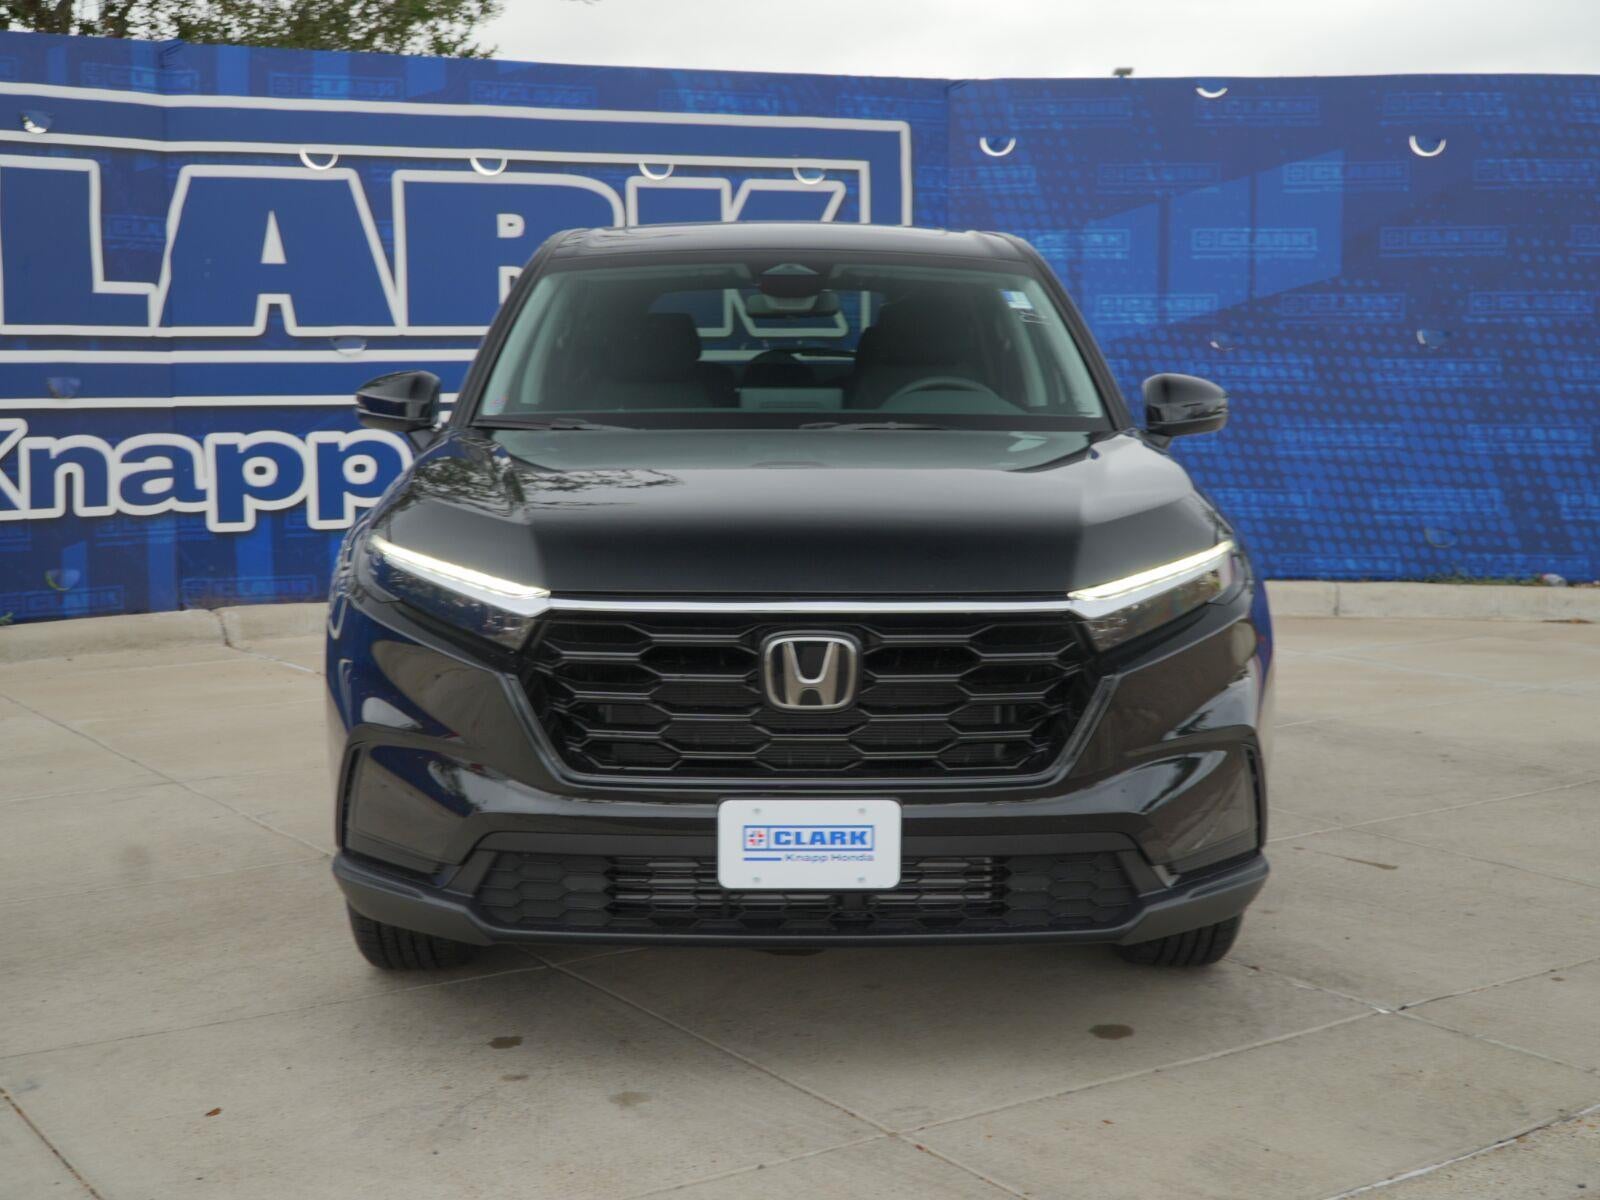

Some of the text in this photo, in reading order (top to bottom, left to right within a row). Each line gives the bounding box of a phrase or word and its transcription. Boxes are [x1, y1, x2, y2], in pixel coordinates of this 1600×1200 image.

[774, 831, 868, 845] CLARK
[785, 854, 874, 863] Knapp Honda
